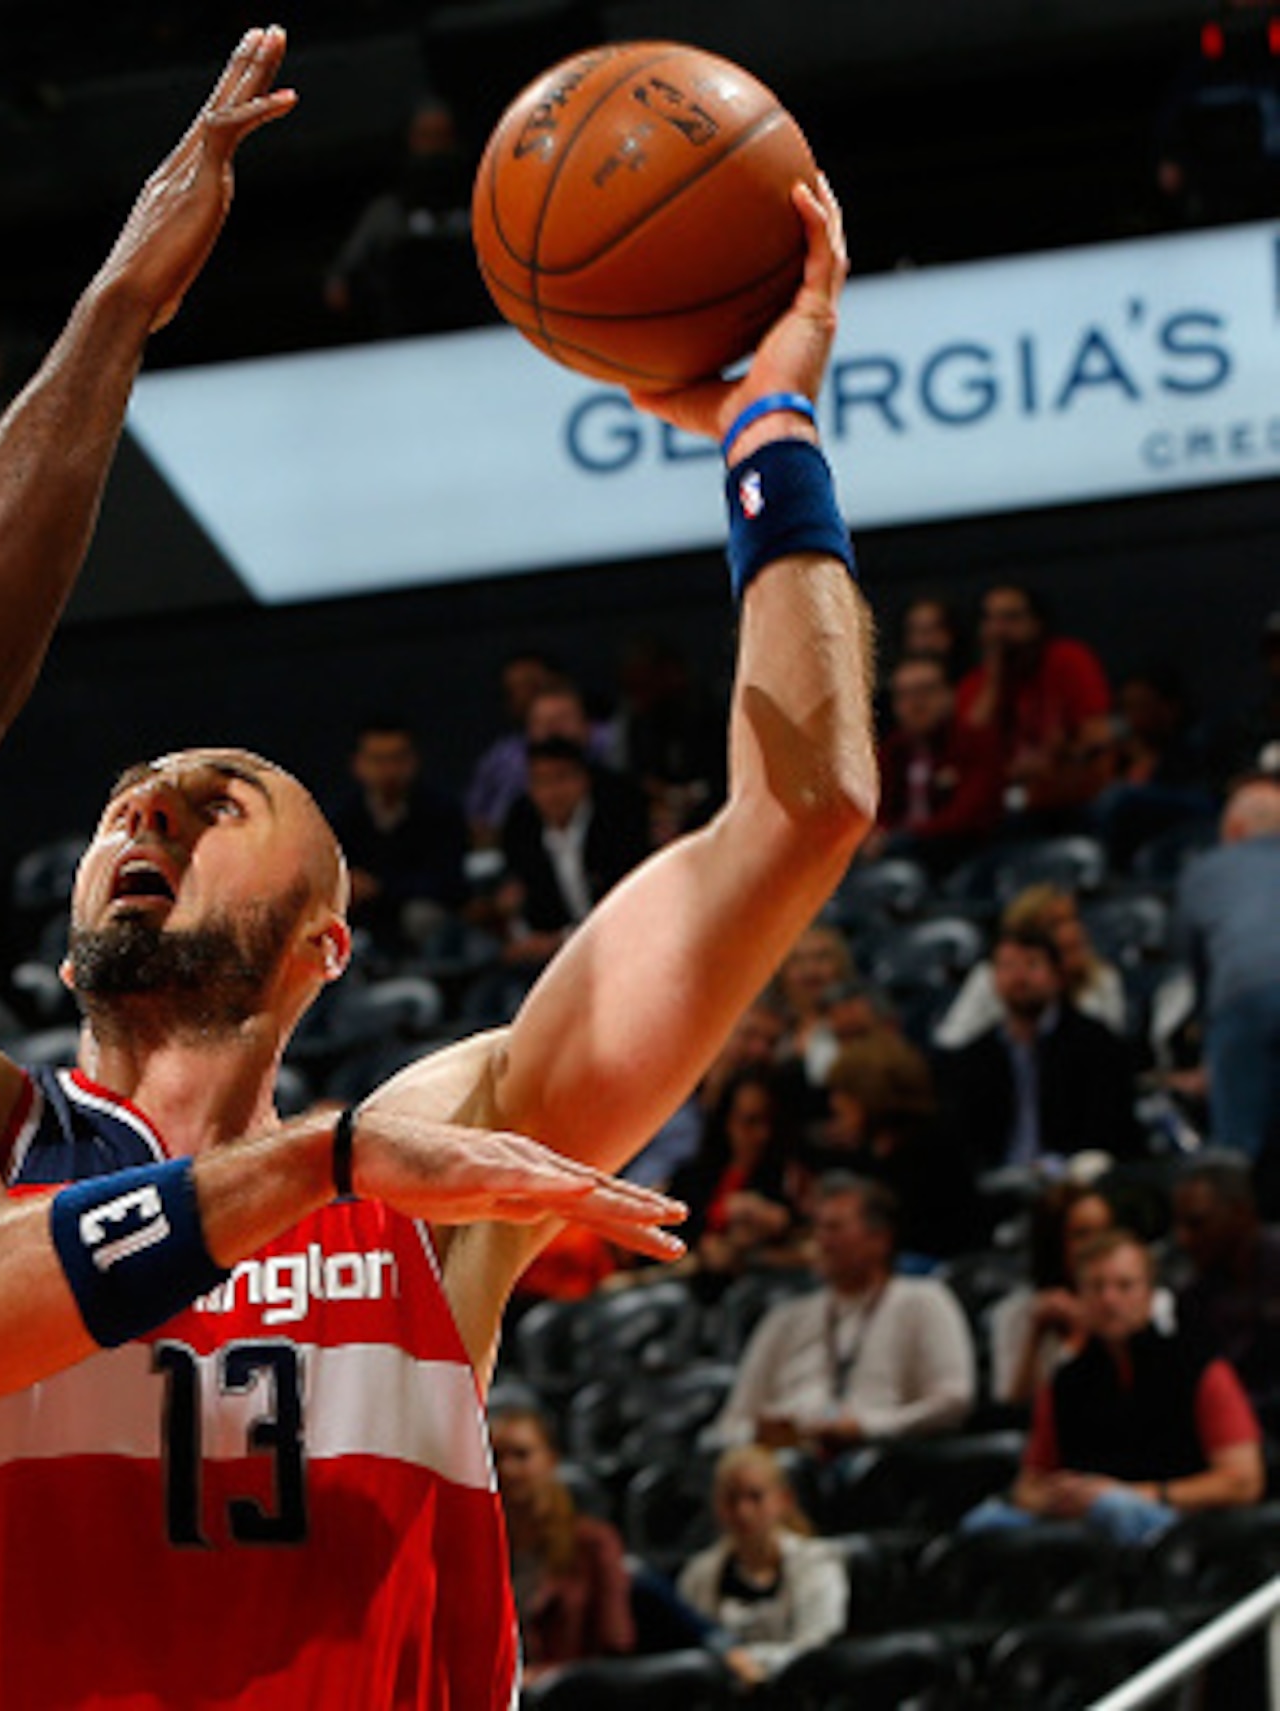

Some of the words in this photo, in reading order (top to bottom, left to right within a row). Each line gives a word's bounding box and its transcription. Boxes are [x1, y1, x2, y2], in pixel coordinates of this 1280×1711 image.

[565, 297, 1231, 475] GRGIA'S
[79, 1184, 171, 1272] 13
[193, 1243, 401, 1325] ngton
[153, 1338, 308, 1550] 13
